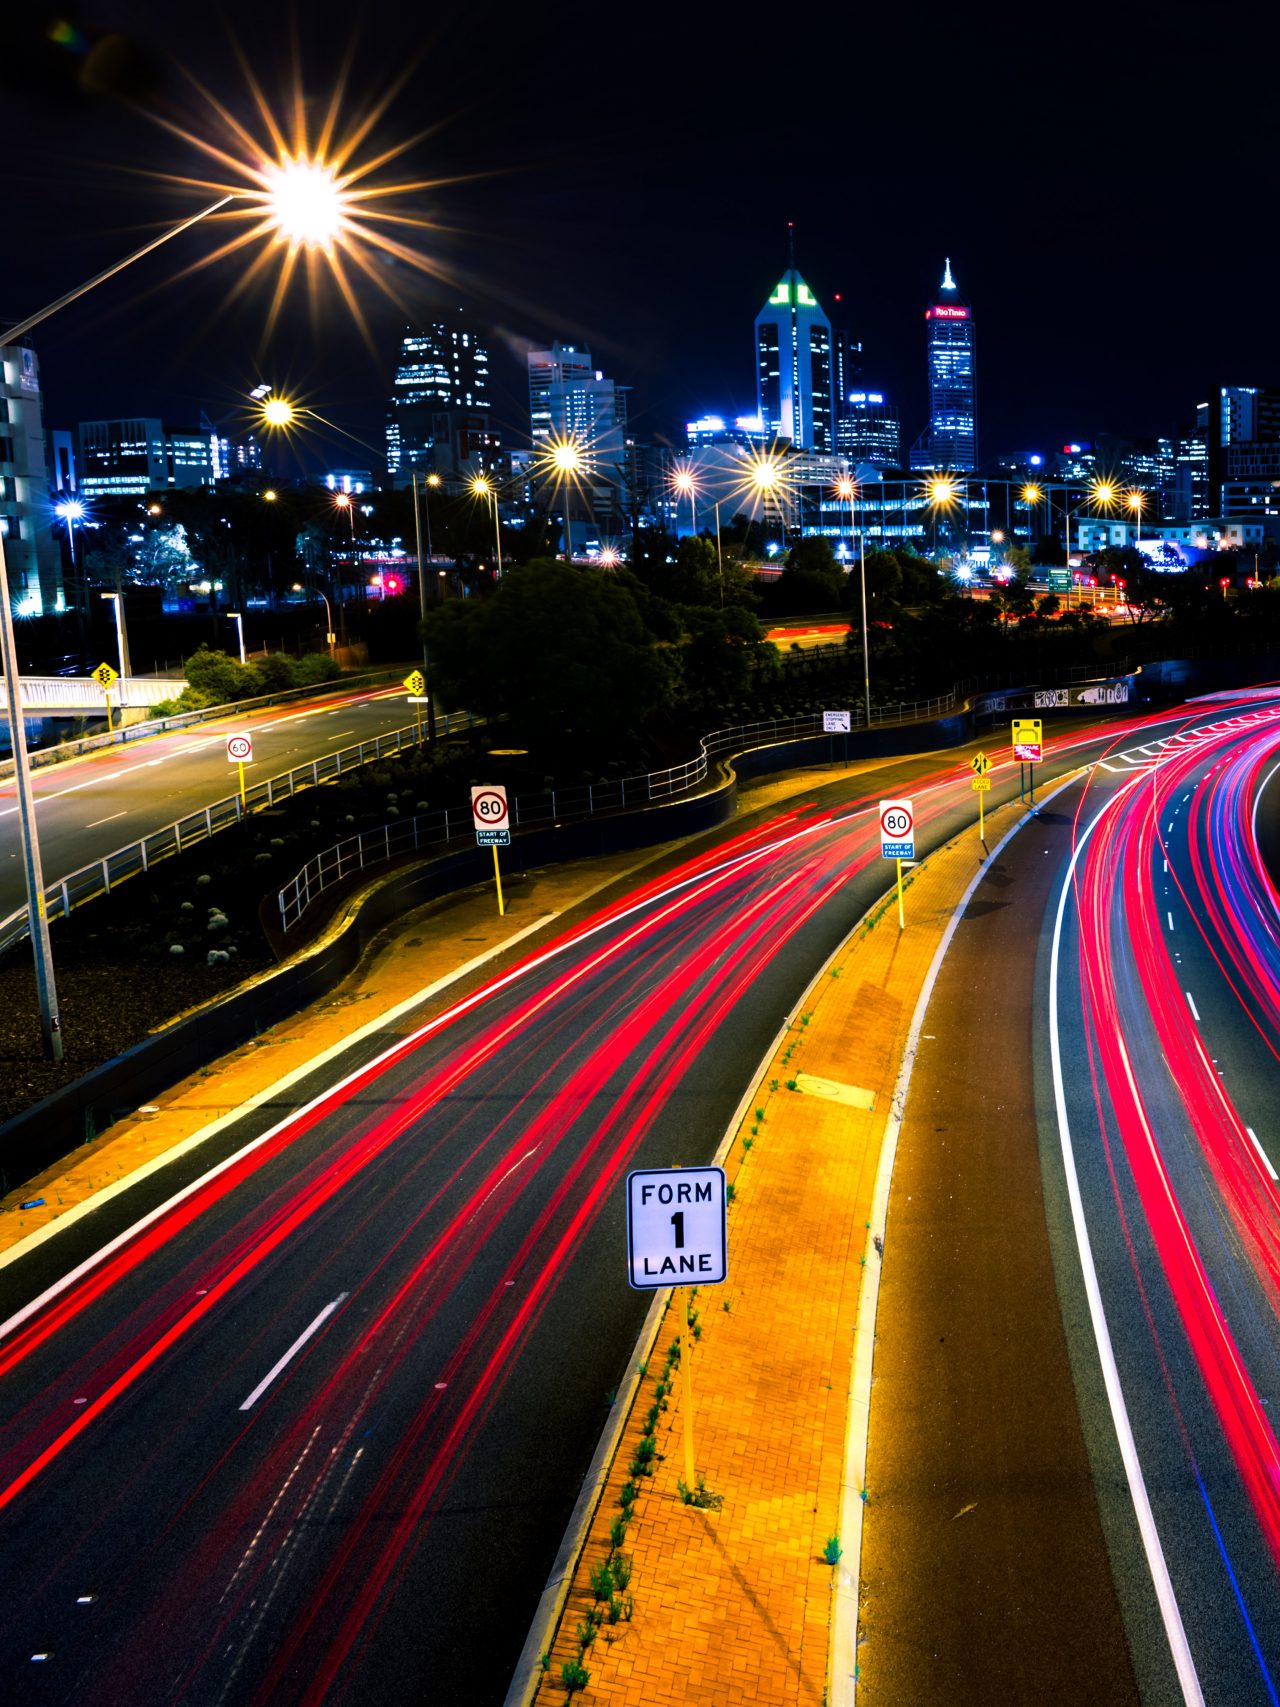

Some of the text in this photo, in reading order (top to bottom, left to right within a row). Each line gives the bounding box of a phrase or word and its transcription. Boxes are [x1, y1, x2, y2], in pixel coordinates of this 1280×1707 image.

[232, 743, 246, 752] 60
[480, 800, 501, 815] 80
[887, 815, 907, 829] 80
[641, 1181, 712, 1206] FORM
[670, 1211, 684, 1249] 1
[644, 1253, 712, 1276] LANE
